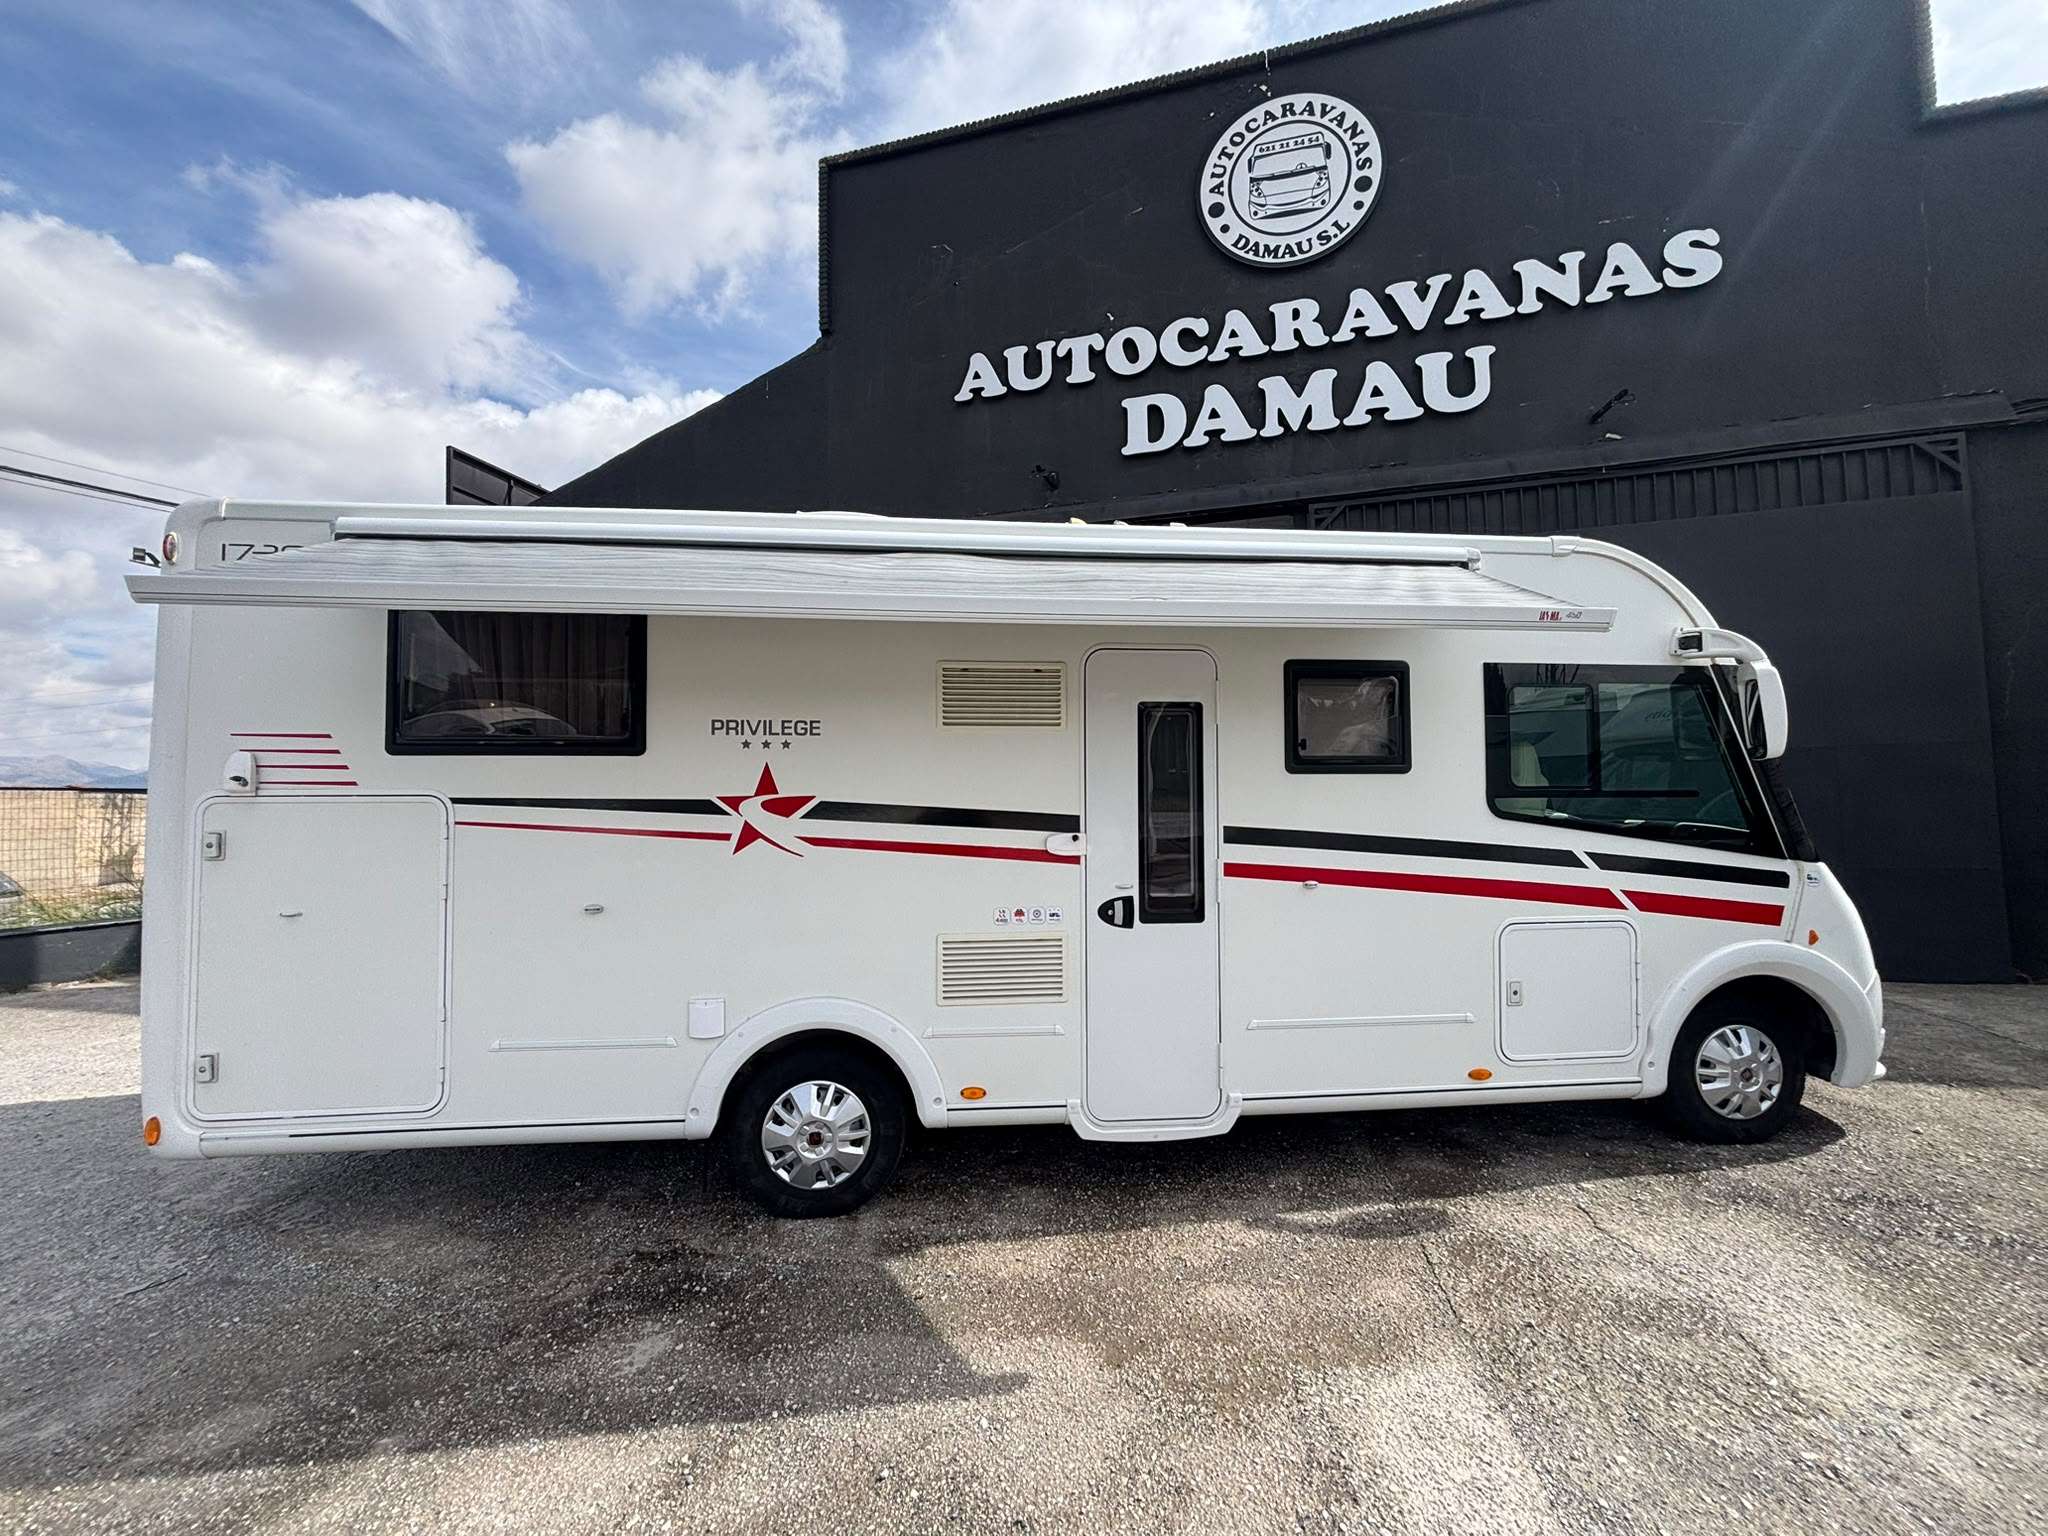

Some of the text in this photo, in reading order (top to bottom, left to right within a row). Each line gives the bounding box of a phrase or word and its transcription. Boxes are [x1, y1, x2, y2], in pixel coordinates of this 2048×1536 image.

[1209, 101, 1373, 196] AUTOCARAVANAS
[1258, 145, 1276, 153] 621
[1293, 138, 1305, 146] 24
[1307, 135, 1320, 144] 54
[1231, 233, 1313, 260] DAMAU
[954, 228, 1723, 402] AUTOCARAVANAS
[1120, 344, 1497, 456] DAMAU
[711, 719, 821, 736] PRIVILEGE
